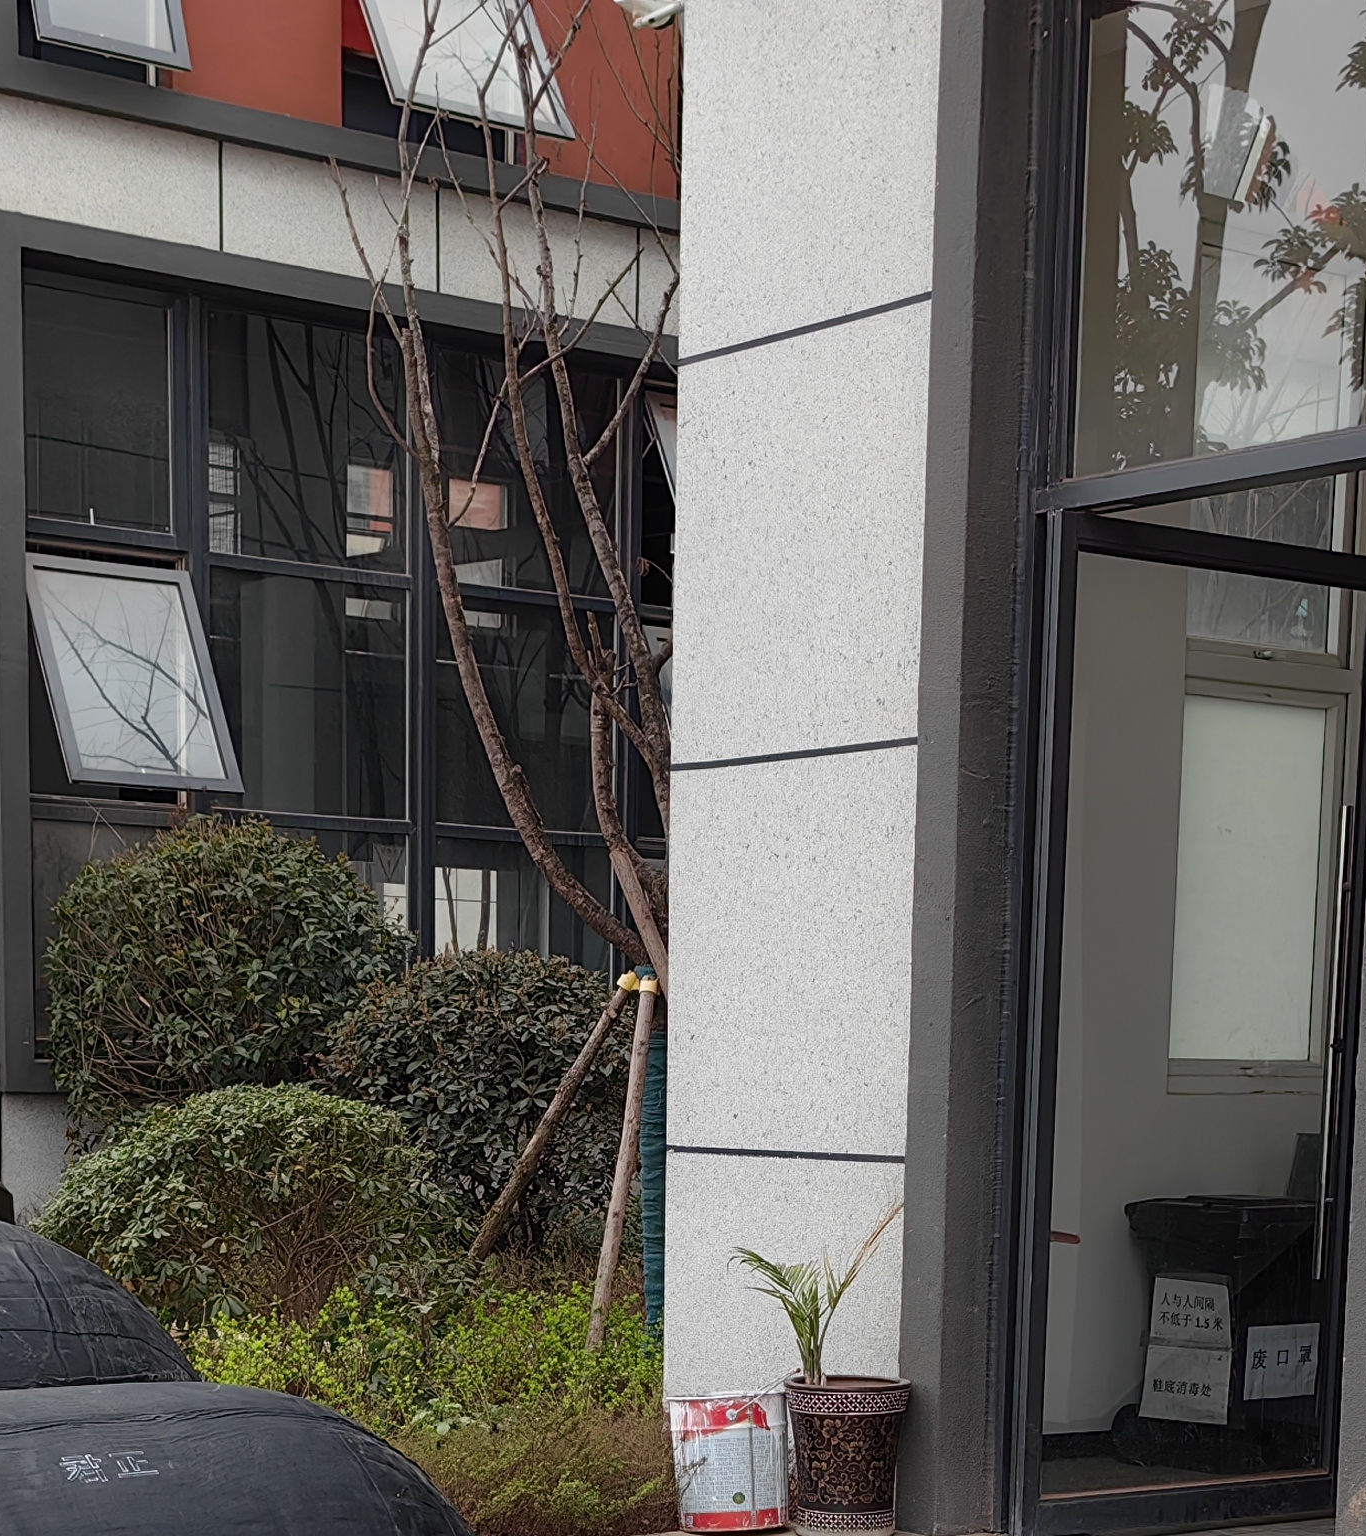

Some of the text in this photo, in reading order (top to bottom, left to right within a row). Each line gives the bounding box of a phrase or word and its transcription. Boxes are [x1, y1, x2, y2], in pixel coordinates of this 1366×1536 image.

[1159, 1291, 1216, 1312] 人与人间隔
[1152, 1378, 1213, 1398] 鞋底消毒处
[59, 1450, 160, 1484] 君正
